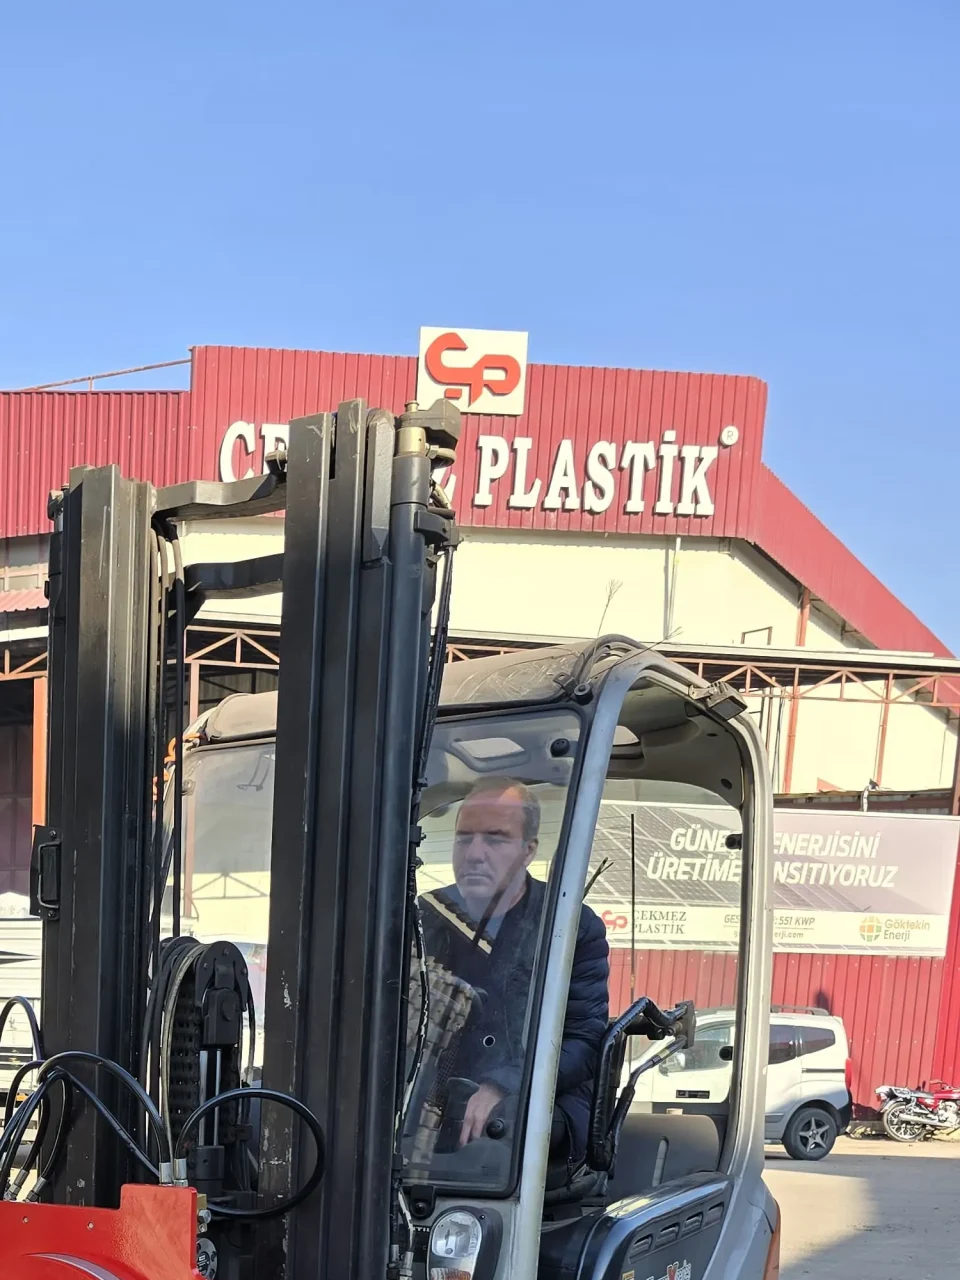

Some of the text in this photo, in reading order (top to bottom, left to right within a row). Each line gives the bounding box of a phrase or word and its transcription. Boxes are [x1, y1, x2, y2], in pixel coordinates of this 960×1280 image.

[473, 430, 719, 517] PLASTİK
[669, 823, 740, 858] GÜNE
[646, 852, 899, 888] ÜRETİME NSITIYORUZ
[883, 929, 911, 942] Enerji
[884, 918, 931, 930] Göktekin
